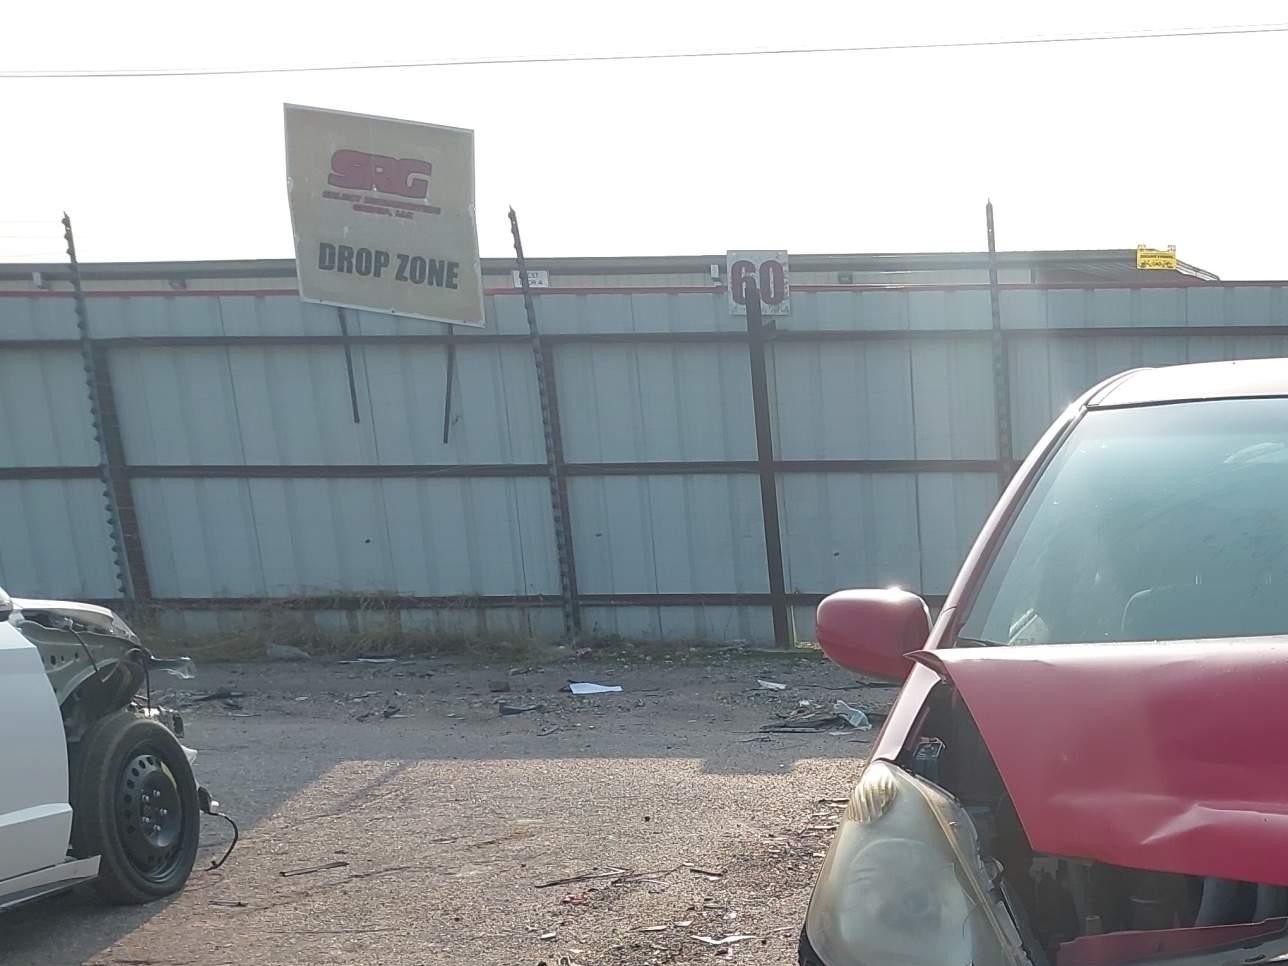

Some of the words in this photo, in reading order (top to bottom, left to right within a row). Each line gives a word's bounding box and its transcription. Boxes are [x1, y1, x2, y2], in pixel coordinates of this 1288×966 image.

[318, 242, 390, 278] DROP
[395, 253, 460, 290] ZONE
[731, 260, 785, 305] 60
